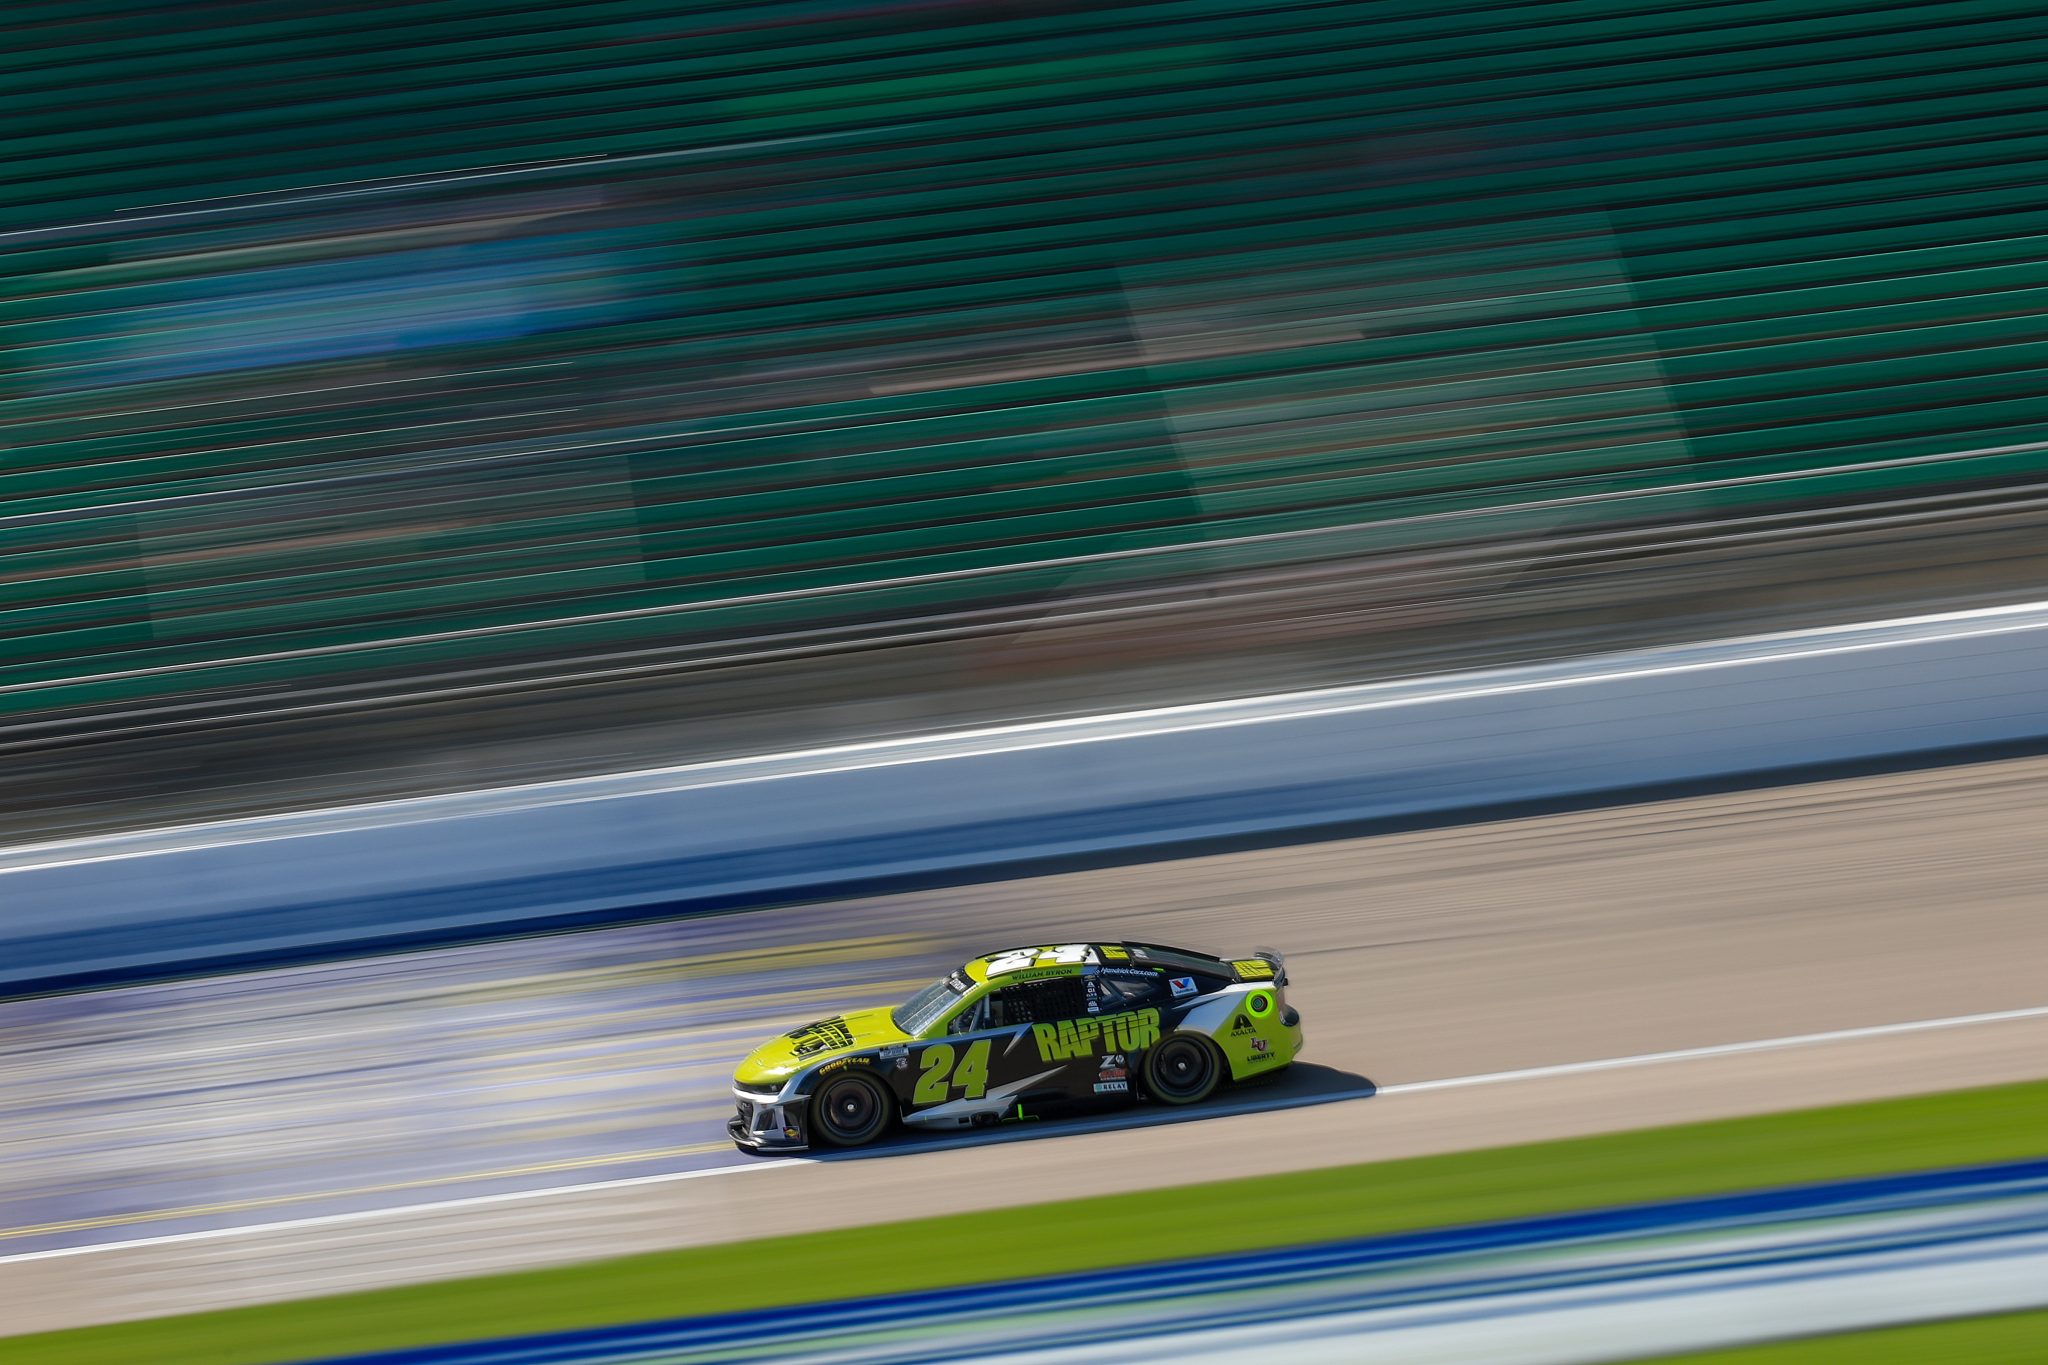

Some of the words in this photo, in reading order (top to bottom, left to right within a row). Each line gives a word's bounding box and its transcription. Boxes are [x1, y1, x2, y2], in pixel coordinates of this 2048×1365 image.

[1011, 972, 1043, 981] WILLIAM
[1045, 969, 1073, 977] BYRON
[1031, 1007, 1161, 1063] RAPTOR
[1230, 1027, 1257, 1037] AXALTA
[1247, 1052, 1275, 1062] LIBERTY
[818, 1056, 870, 1076] GOODYEAR
[912, 1039, 992, 1104] 24
